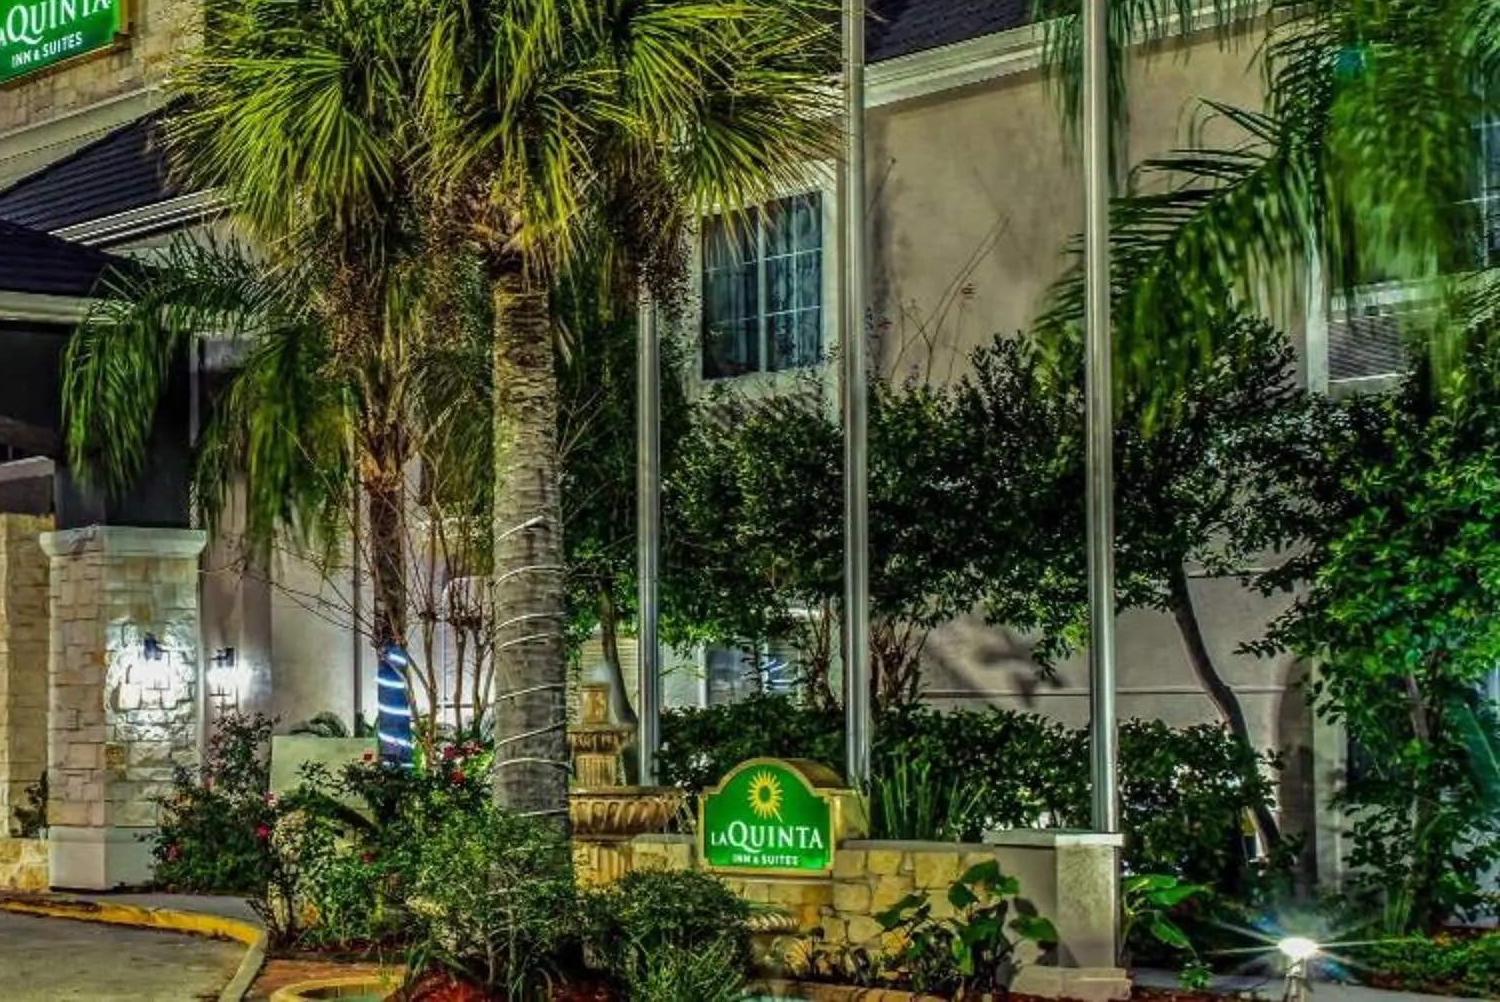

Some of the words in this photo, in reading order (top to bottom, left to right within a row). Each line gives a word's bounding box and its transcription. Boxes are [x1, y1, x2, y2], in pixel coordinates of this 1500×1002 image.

[11, 50, 32, 67] INN
[33, 47, 41, 61] &
[43, 31, 84, 58] SUITES
[710, 831, 728, 846] LA
[727, 820, 824, 853] QUINTA
[732, 853, 751, 864] INN
[761, 854, 800, 865] SUITES
